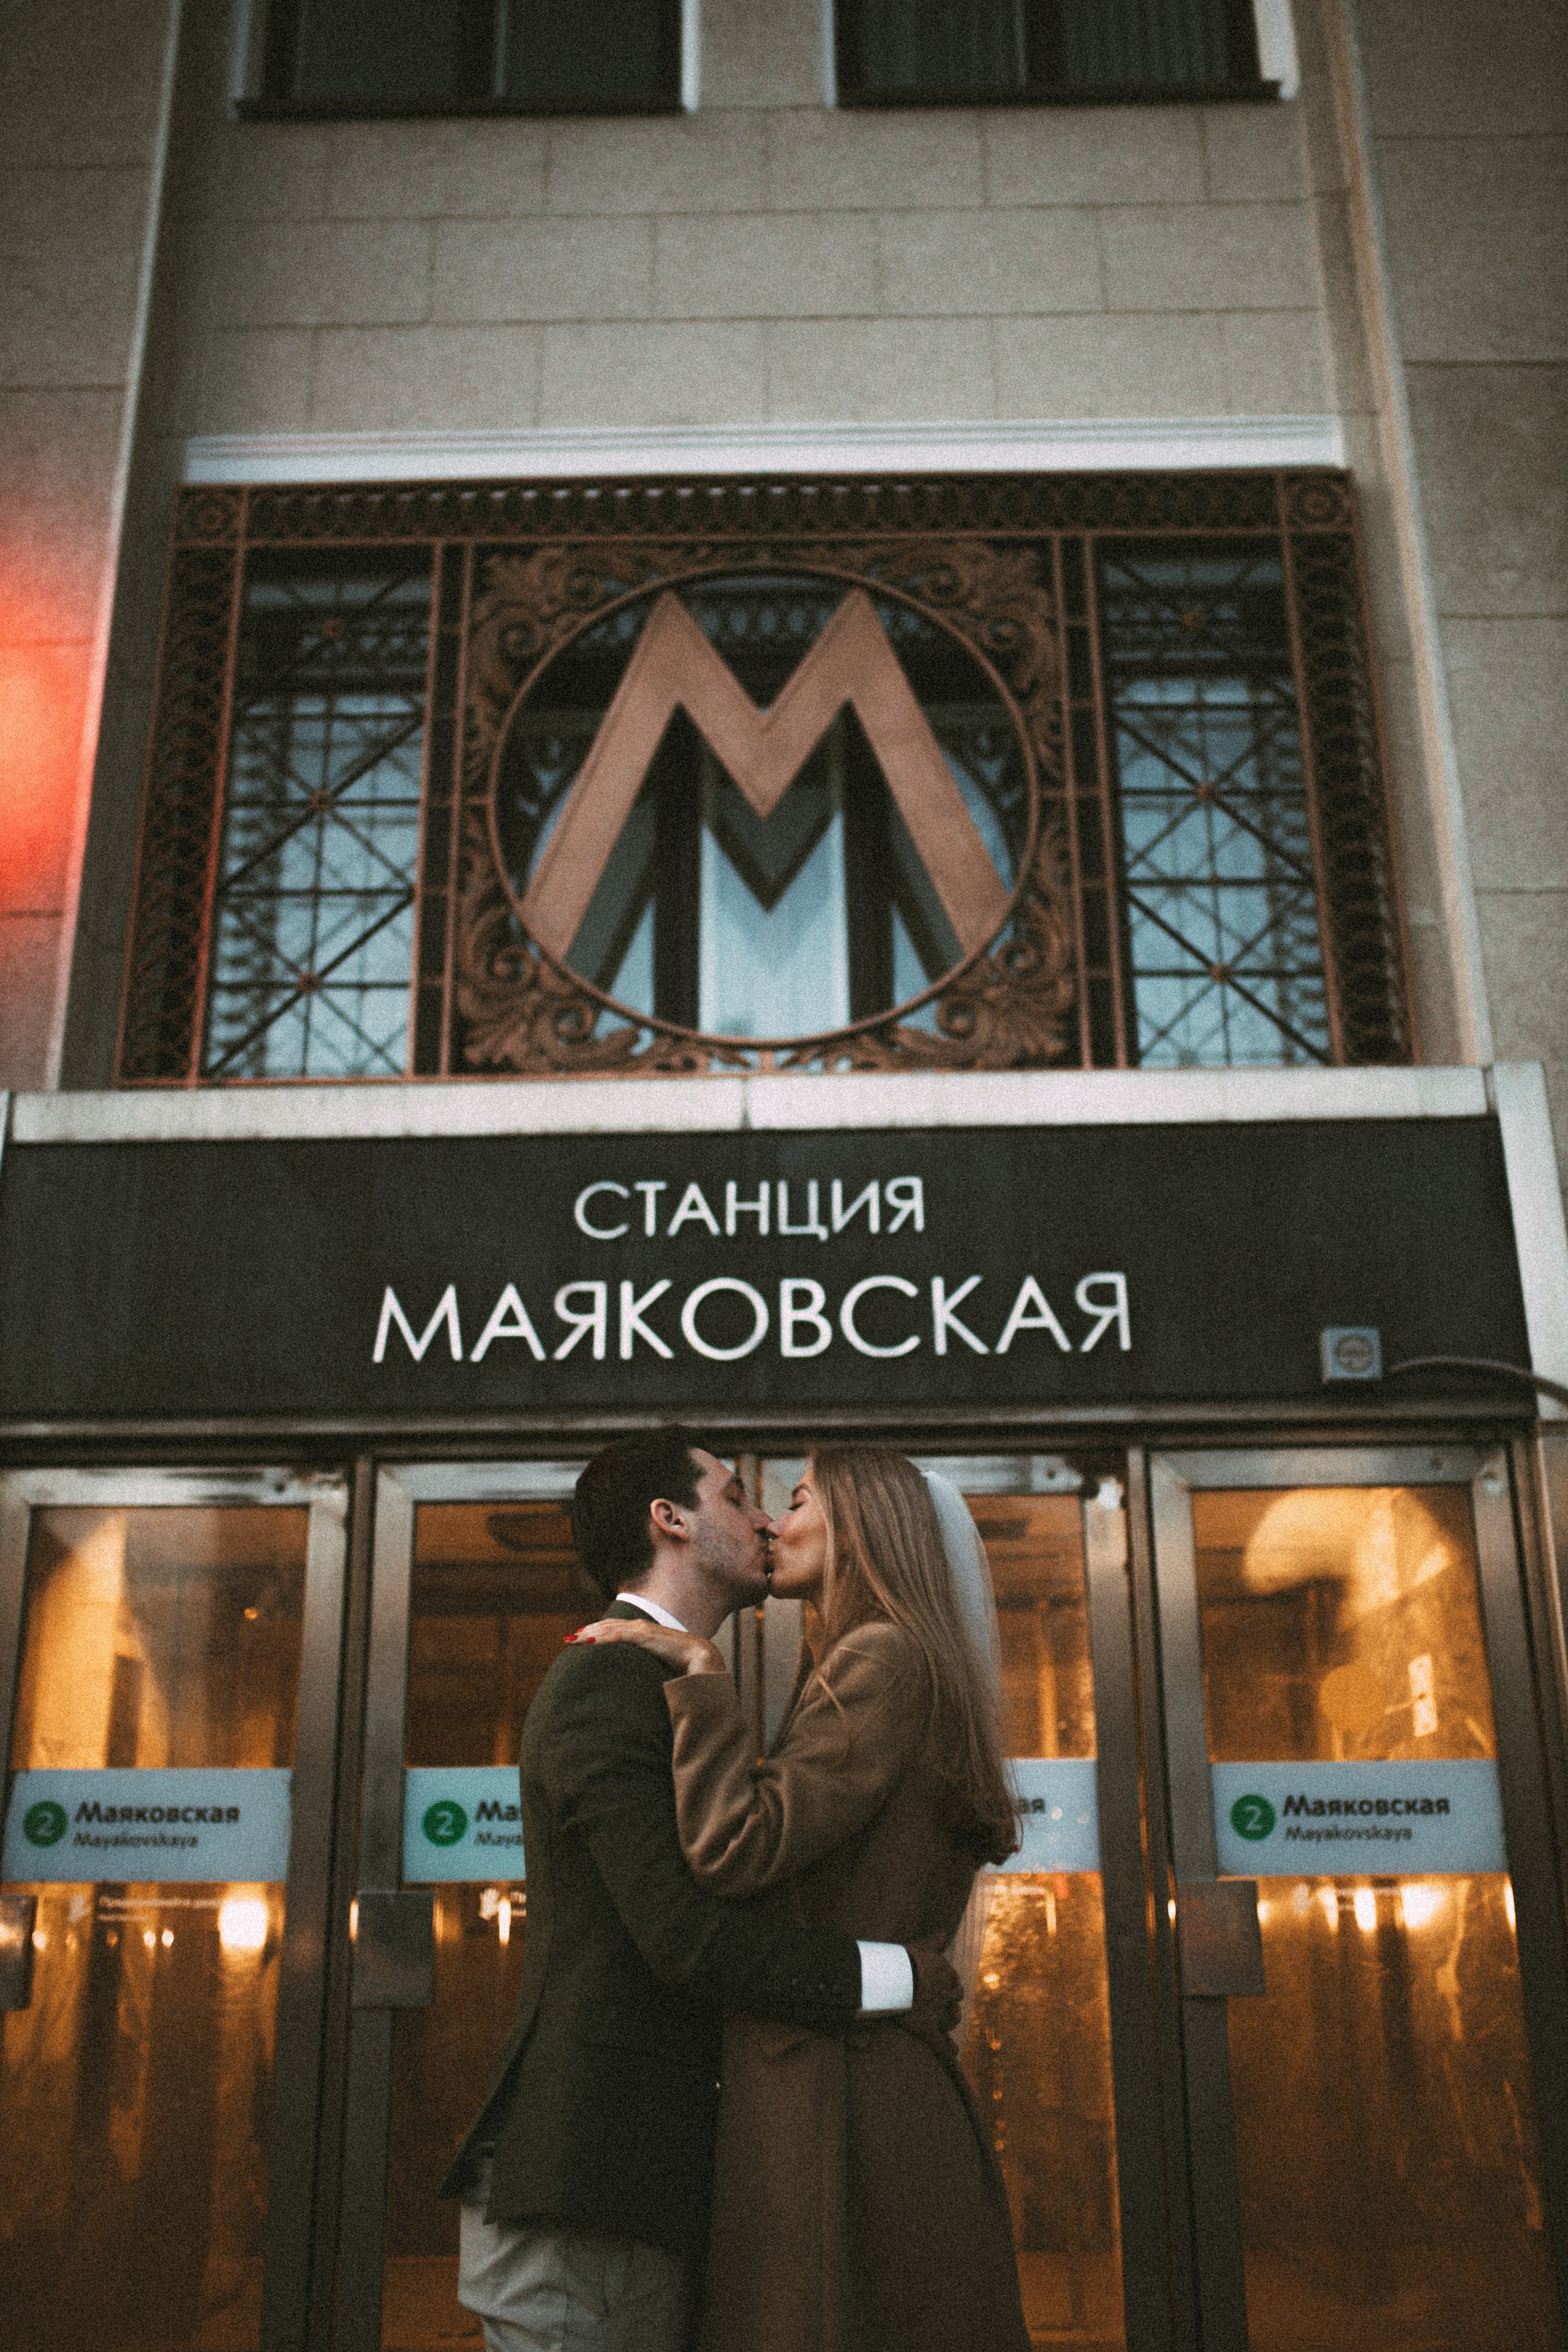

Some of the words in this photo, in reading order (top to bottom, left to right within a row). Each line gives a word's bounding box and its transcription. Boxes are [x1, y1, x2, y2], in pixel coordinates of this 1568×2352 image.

[574, 1176, 925, 1241] СТАНЦИЯ
[372, 1272, 1132, 1363] МАЯКОВСКАЯ
[74, 1801, 241, 1824] Маяковская
[1244, 1806, 1263, 1831] 2
[1283, 1795, 1450, 1817] Маяковская
[34, 1810, 55, 1836] 2
[436, 1811, 454, 1836] 2
